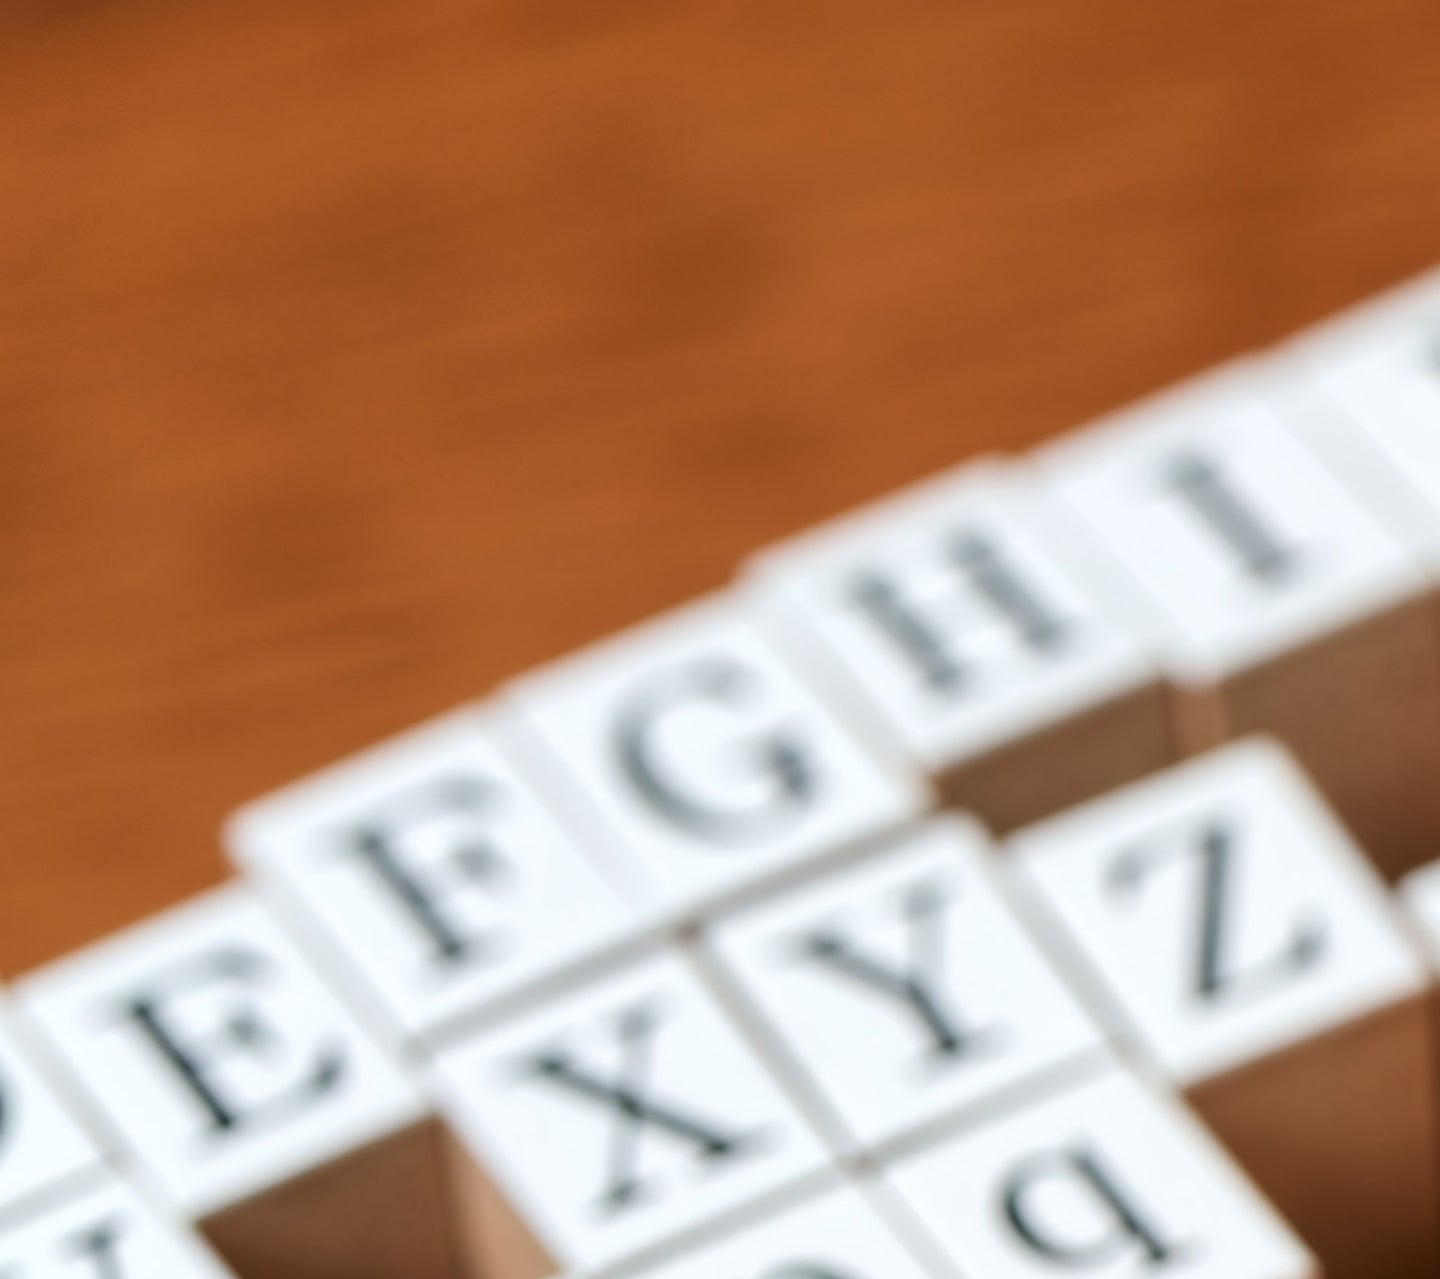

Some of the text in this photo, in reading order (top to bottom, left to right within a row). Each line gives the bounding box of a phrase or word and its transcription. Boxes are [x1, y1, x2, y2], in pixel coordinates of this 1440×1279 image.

[88, 935, 350, 1145] E
[312, 770, 518, 972] F
[602, 650, 822, 850] G
[840, 520, 1072, 700] H
[498, 990, 778, 1214] X
[772, 875, 1010, 1075] Y
[1098, 808, 1330, 1015] Z
